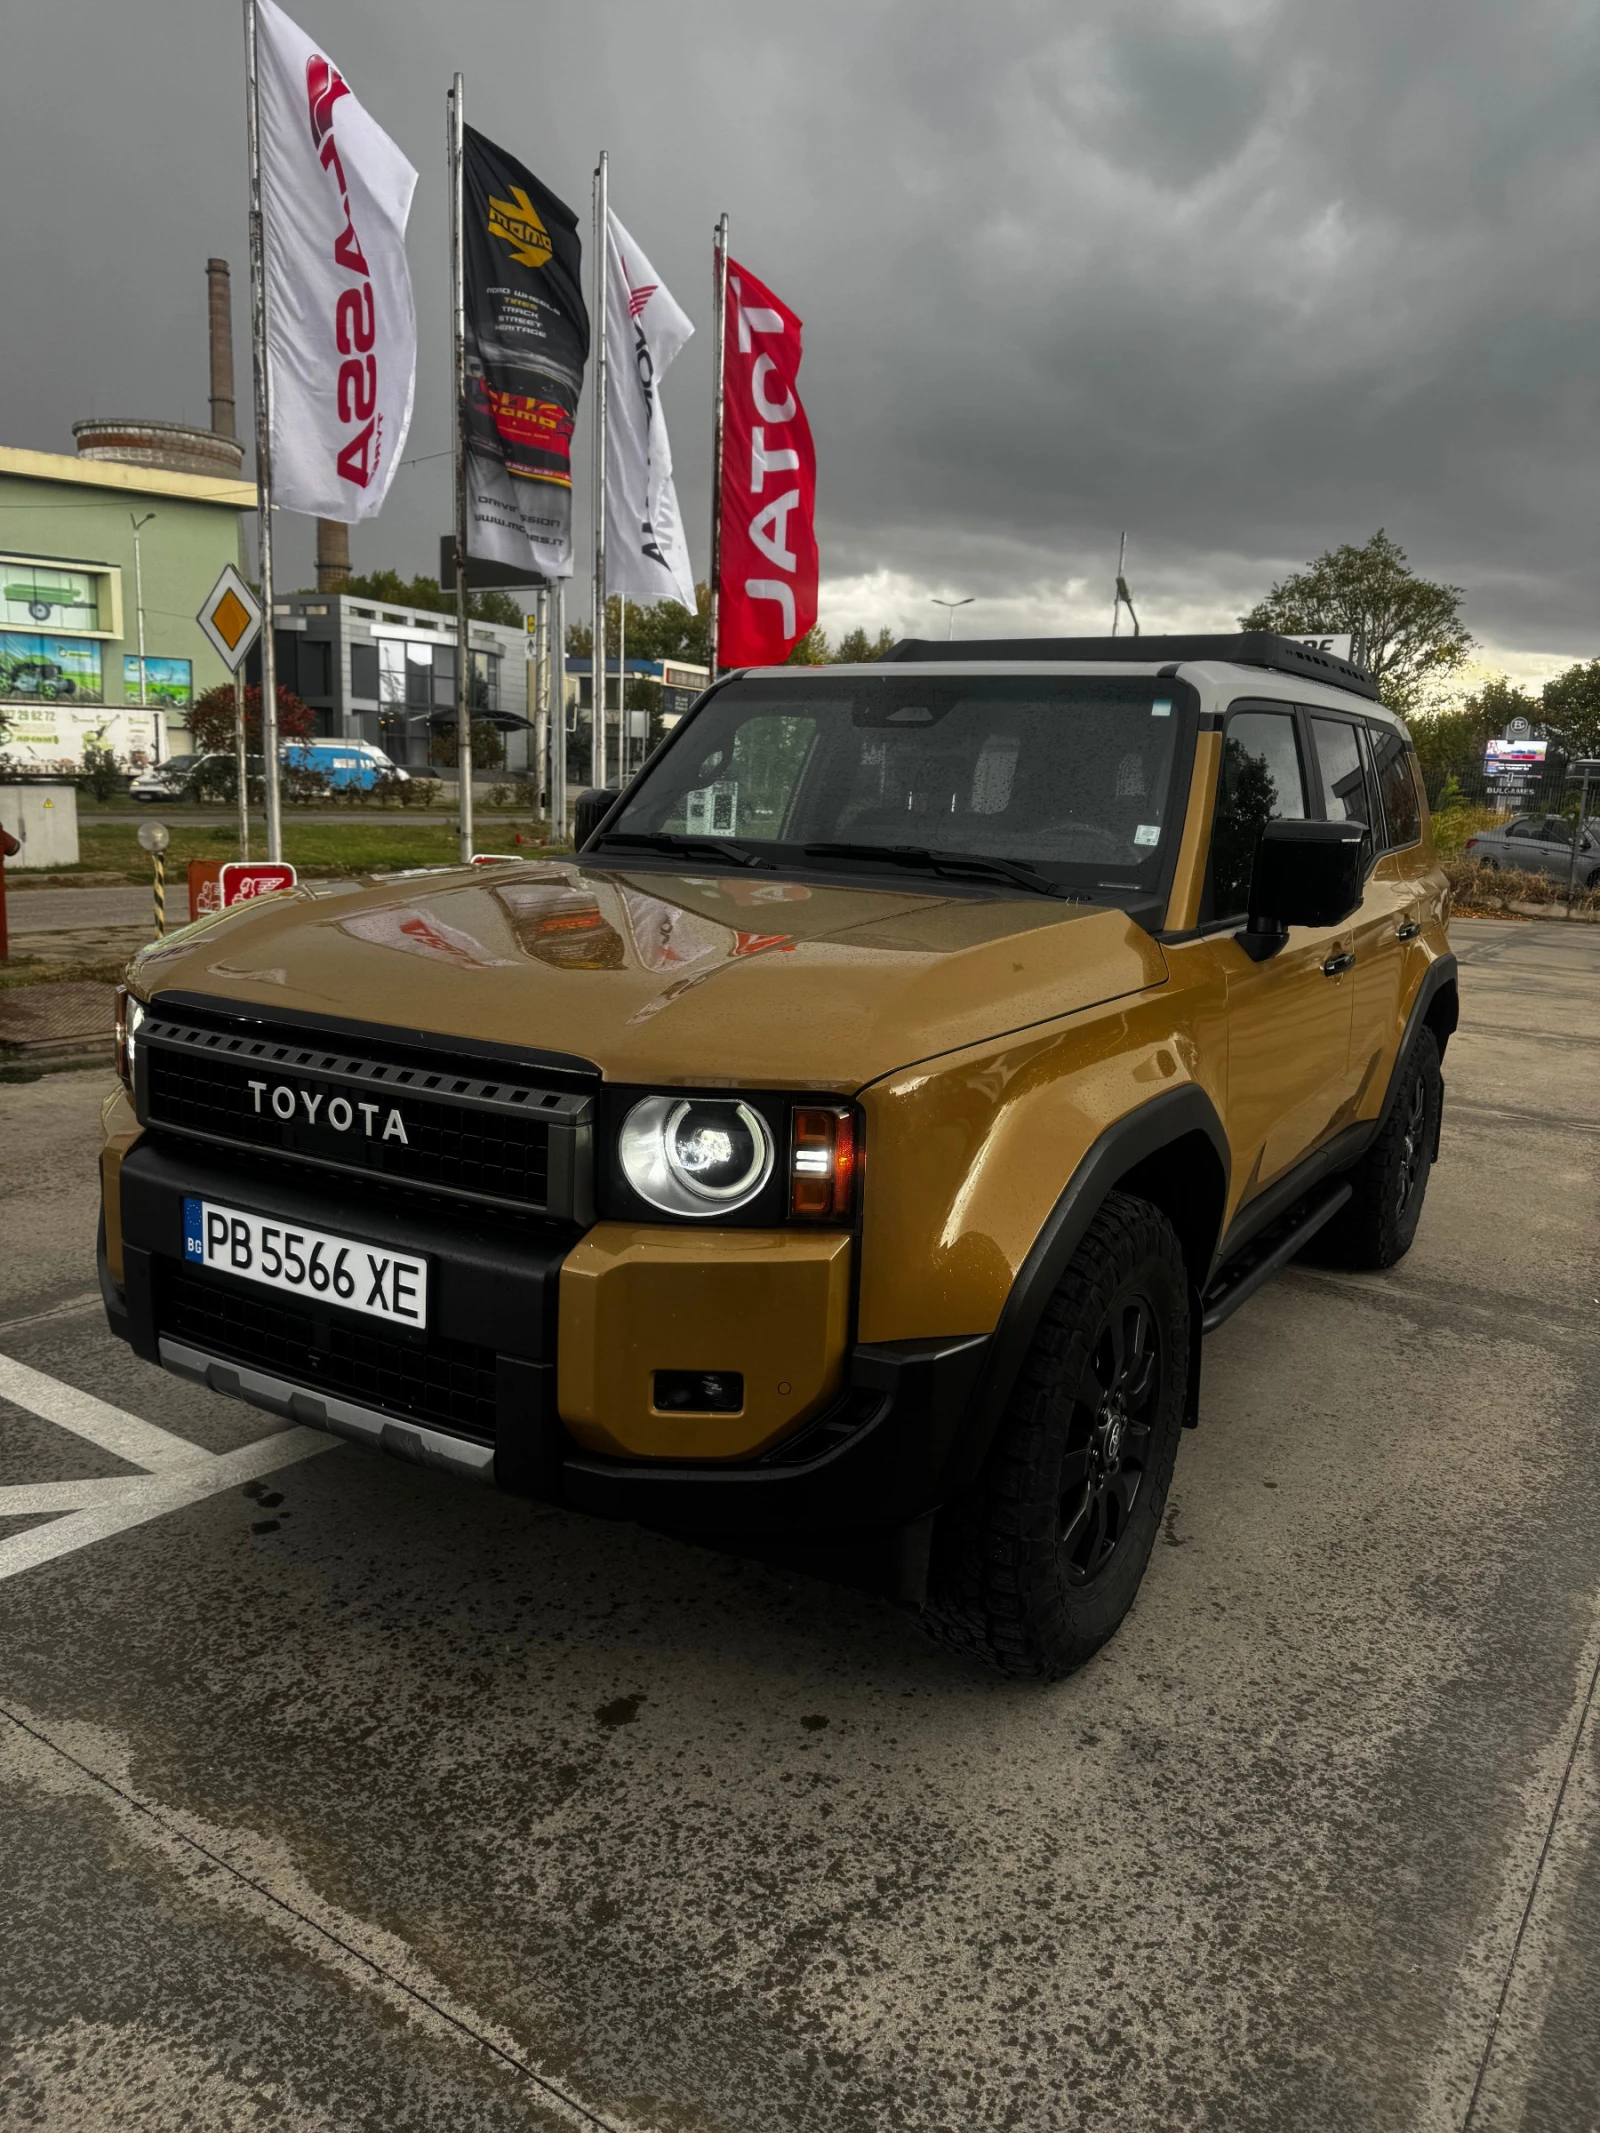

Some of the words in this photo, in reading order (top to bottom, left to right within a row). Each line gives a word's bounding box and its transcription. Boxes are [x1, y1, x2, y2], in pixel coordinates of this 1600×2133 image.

[504, 296, 538, 311] TIRES
[514, 290, 561, 316] WHEELS
[501, 305, 540, 319] TRACK
[498, 315, 543, 329] STREET
[495, 324, 547, 339] HERITAGE
[1486, 786, 1535, 796] BULGAMES
[248, 1080, 409, 1144] TOYOTA
[187, 1237, 202, 1255] BG
[207, 1210, 253, 1270] PB
[261, 1225, 355, 1299] 5566
[365, 1253, 419, 1320] XE
